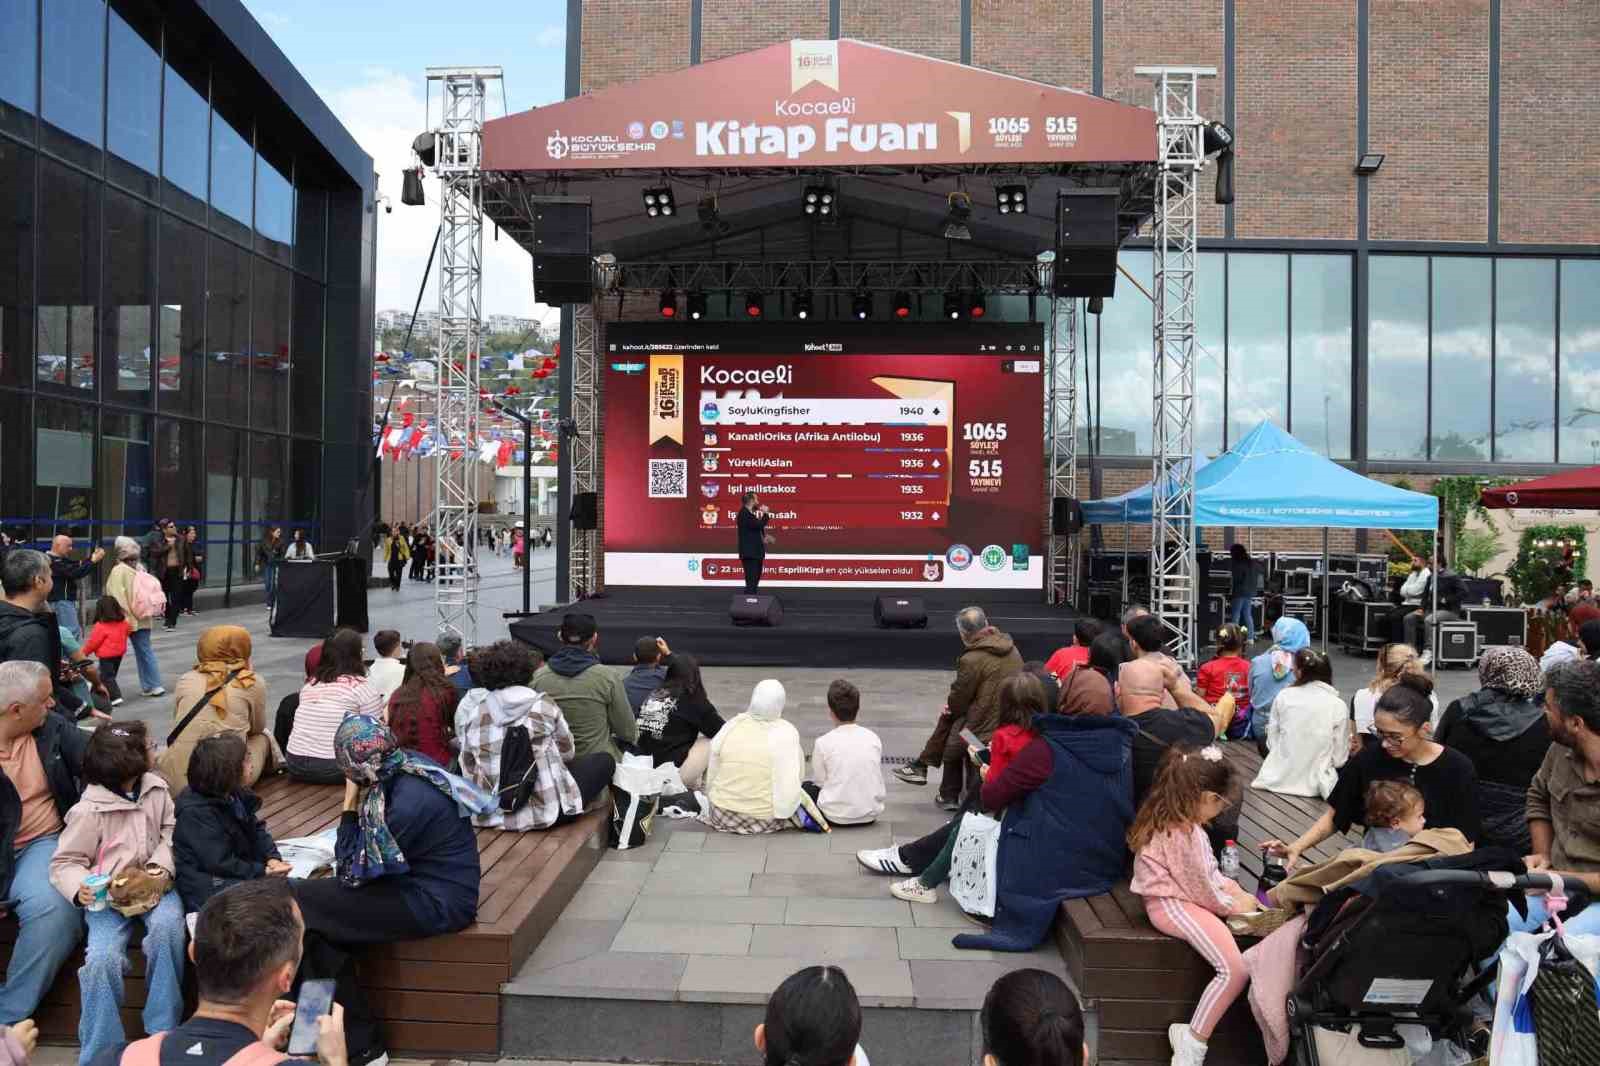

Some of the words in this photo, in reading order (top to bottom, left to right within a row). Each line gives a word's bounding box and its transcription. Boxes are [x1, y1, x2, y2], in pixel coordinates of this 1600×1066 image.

[775, 97, 856, 116] Kocaeli
[988, 117, 1030, 134] 1065
[1046, 117, 1077, 134] 515
[695, 120, 816, 159] Kitap
[825, 117, 937, 152] Fuarı
[701, 365, 793, 385] Kocaeli
[728, 405, 811, 417] SoyluKingfisher
[900, 407, 925, 416] 1940
[728, 432, 792, 441] KanatlıOriks
[794, 432, 830, 443] (Afrika
[832, 432, 881, 443] Antilobu)
[901, 433, 924, 442] 1936
[963, 422, 1008, 441] 1065
[728, 458, 792, 468] YürekliAslan
[901, 459, 924, 468] 1936
[969, 459, 1003, 477] 515
[901, 485, 924, 494] 1935
[901, 511, 924, 520] 1932
